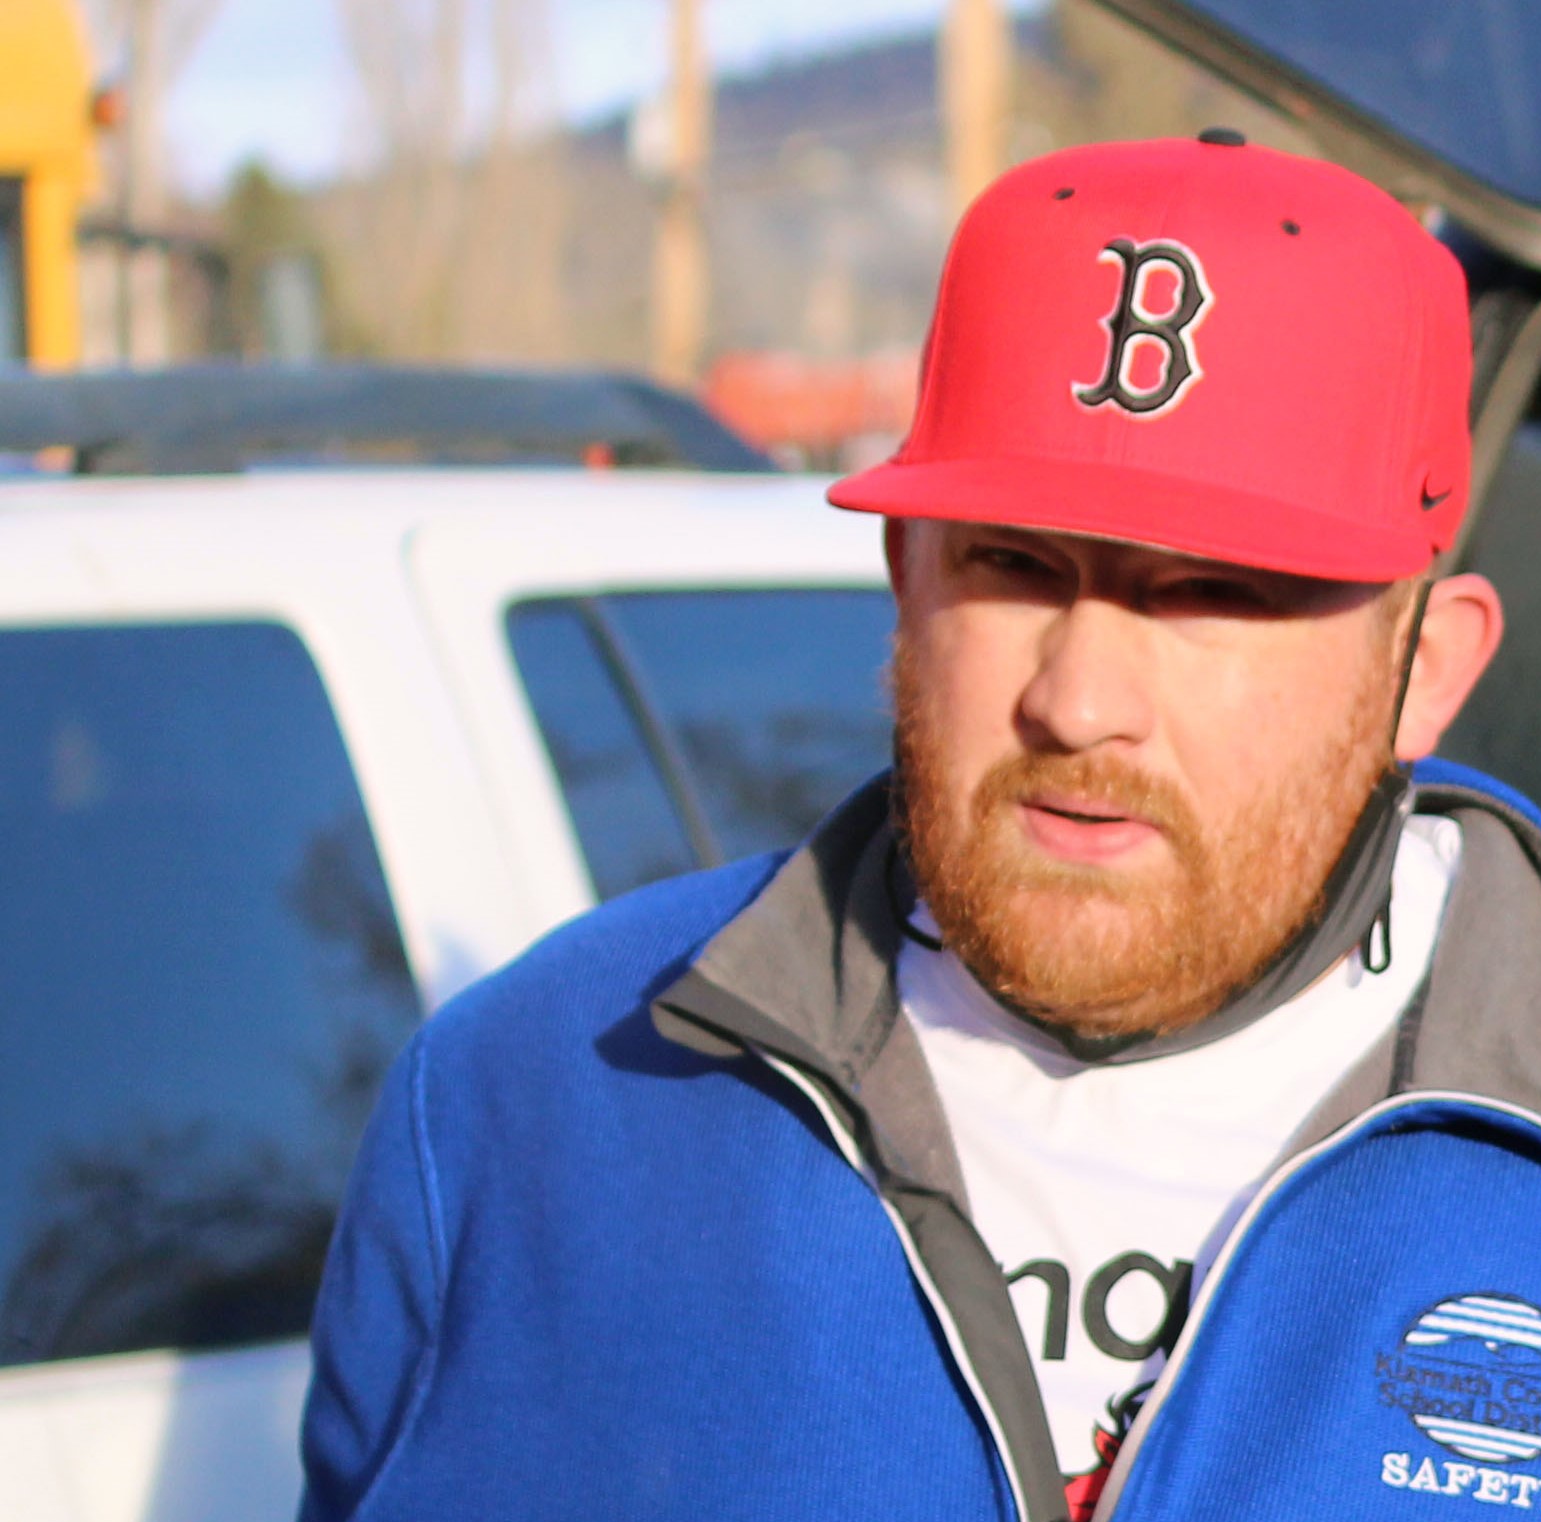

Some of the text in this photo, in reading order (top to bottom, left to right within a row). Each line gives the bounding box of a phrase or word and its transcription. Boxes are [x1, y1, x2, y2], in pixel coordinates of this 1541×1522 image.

[1071, 234, 1215, 421] B
[1376, 1351, 1492, 1397] Klamath
[1378, 1380, 1476, 1420] School
